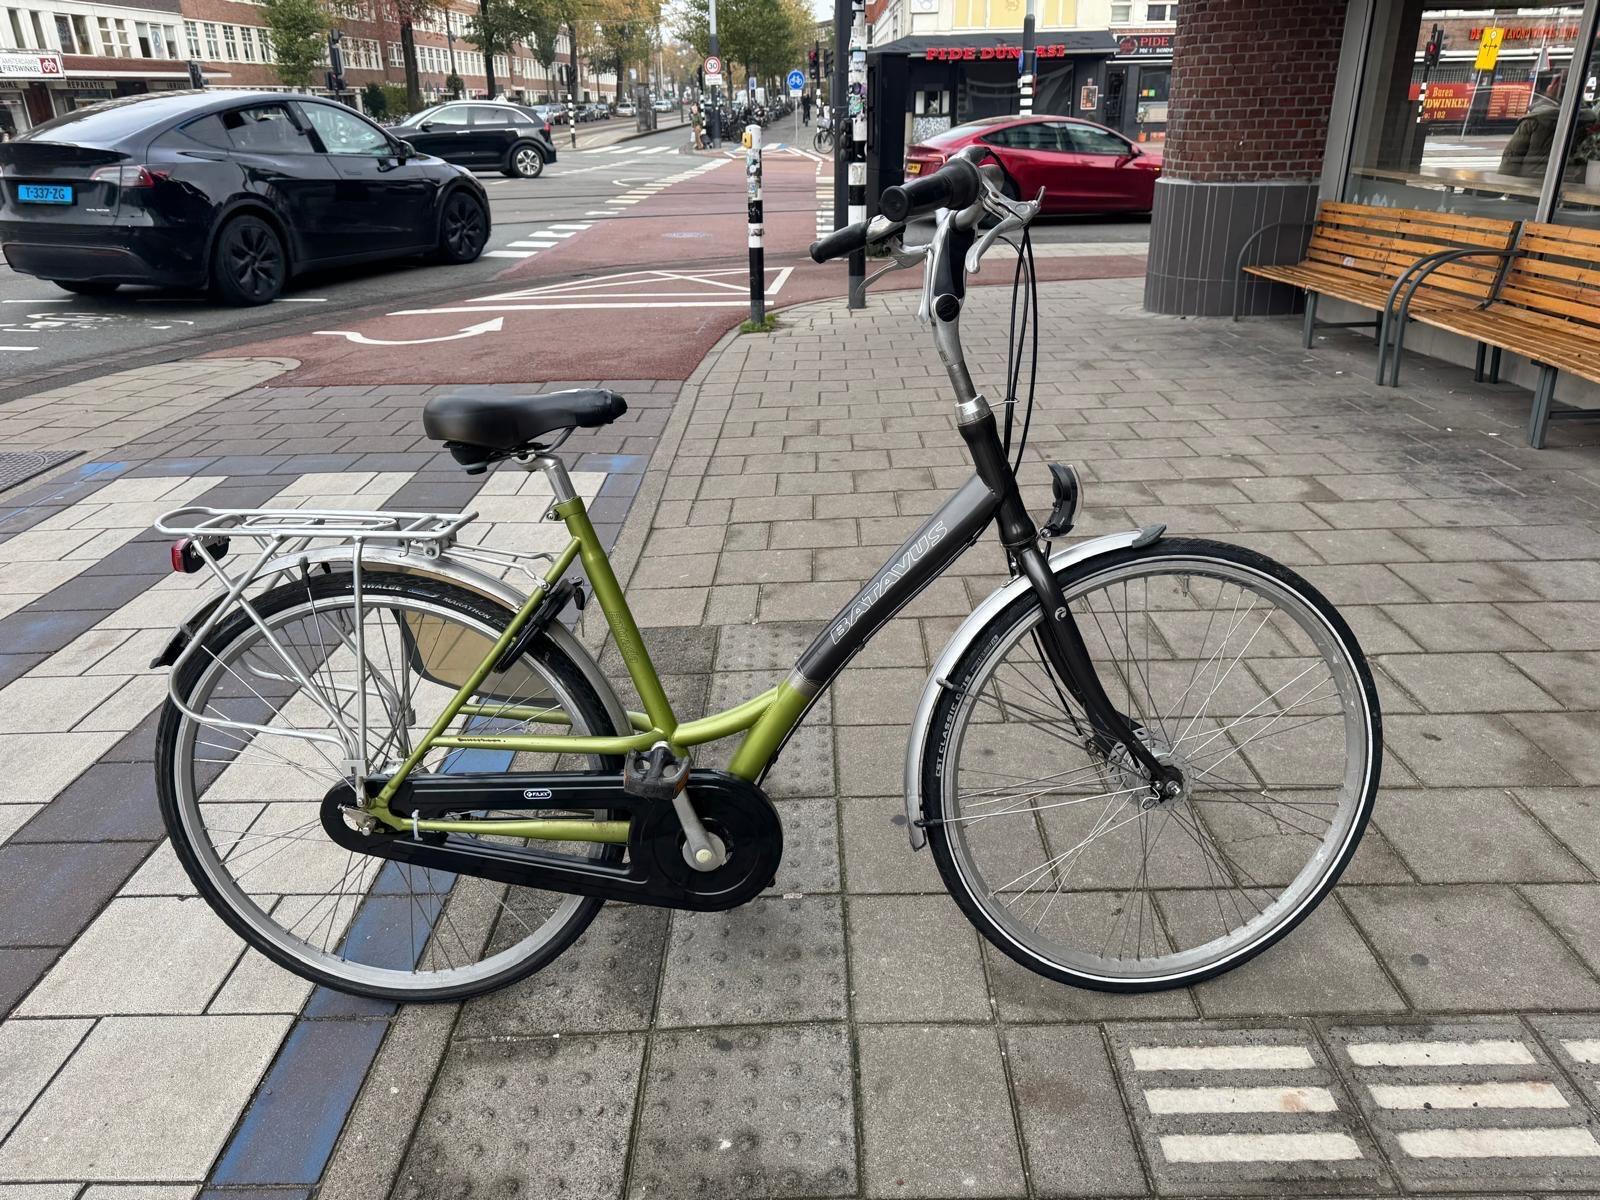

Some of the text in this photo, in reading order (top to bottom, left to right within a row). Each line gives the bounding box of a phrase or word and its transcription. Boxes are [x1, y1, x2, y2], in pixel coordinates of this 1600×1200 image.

[926, 43, 1065, 60] PIDE DÜNASI
[1140, 37, 1170, 47] PIDE
[708, 62, 718, 70] 30
[830, 520, 948, 645] BATAVUS
[443, 597, 492, 620] MARATHON
[938, 704, 958, 753] CLASSIC
[935, 757, 944, 777] CST
